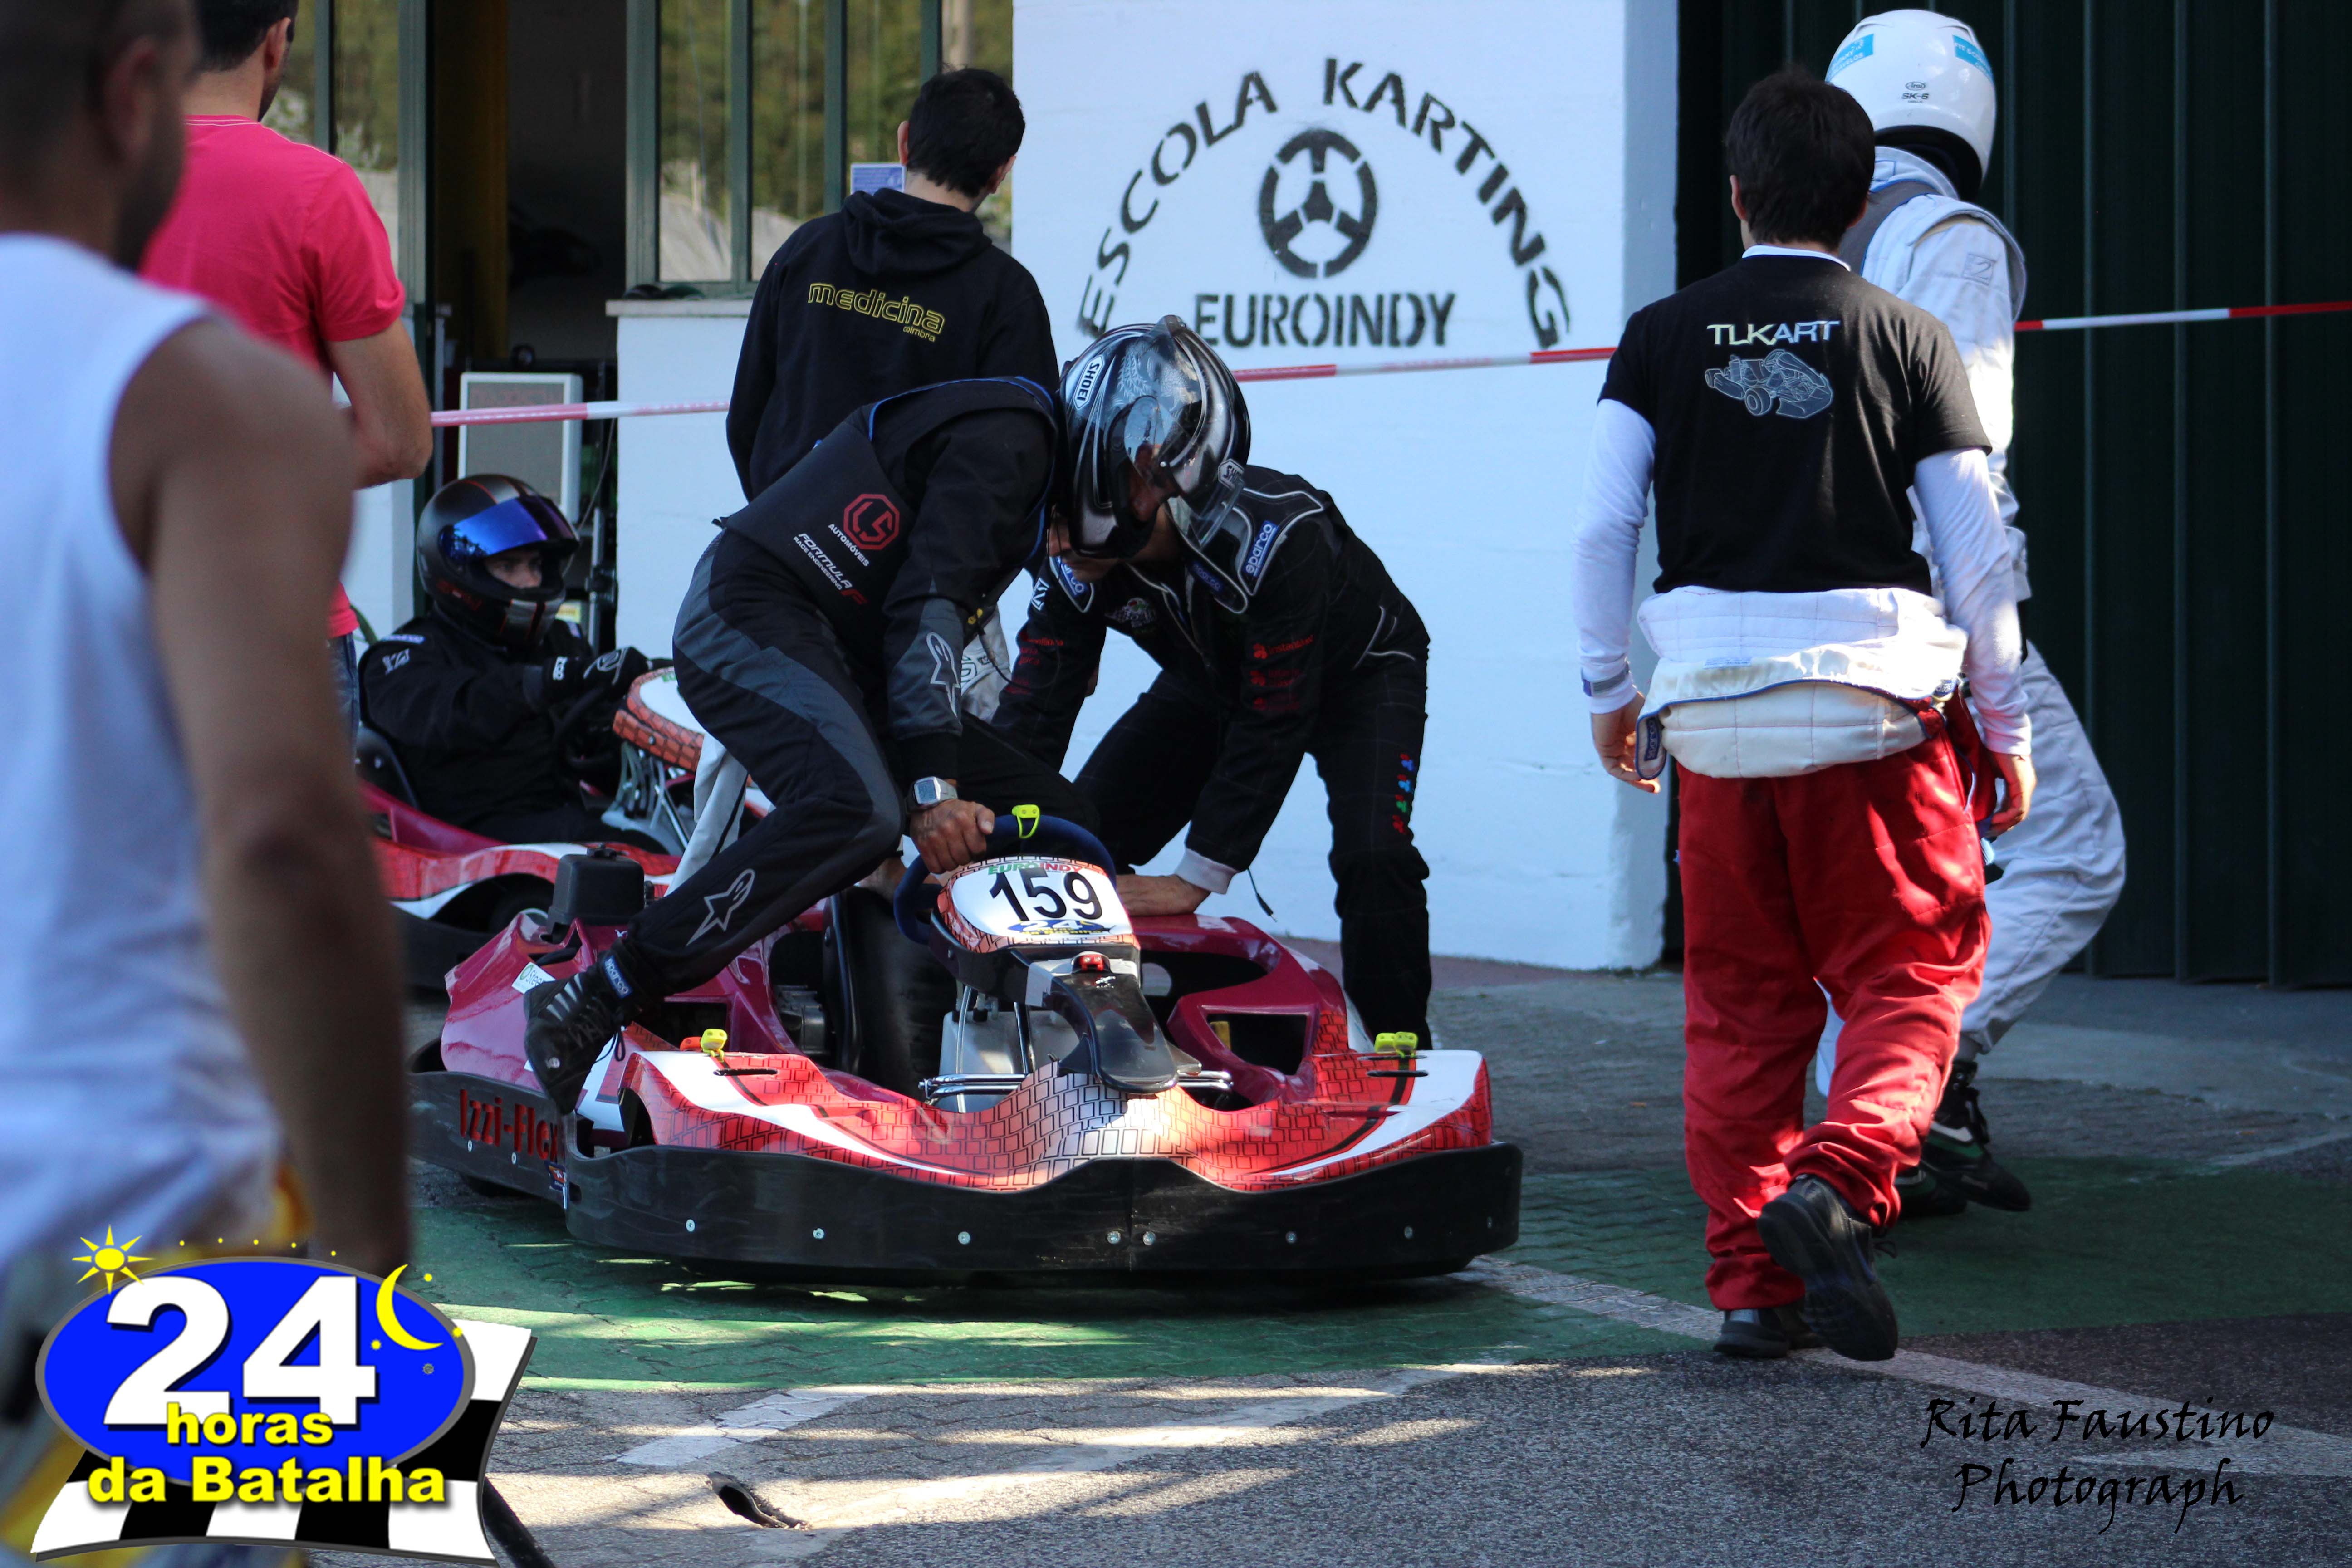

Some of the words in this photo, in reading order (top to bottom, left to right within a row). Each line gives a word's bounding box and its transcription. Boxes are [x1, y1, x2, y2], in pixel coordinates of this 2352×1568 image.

[1076, 70, 1278, 338] ESCOLA
[1323, 57, 1570, 350] KARTING
[808, 283, 946, 335] medicina
[1195, 294, 1455, 348] EUROINDY
[1706, 320, 1841, 346] TLKART
[903, 326, 936, 343] coimbra
[1076, 363, 1100, 401] SHOEI
[794, 536, 809, 555] RACE
[808, 552, 843, 590] ENGINEERING
[798, 533, 853, 588] FORMULA
[828, 524, 870, 567] AUTOMÓVEIS
[1245, 524, 1273, 574] sparco
[988, 862, 1083, 875] EUROINDY
[989, 867, 1102, 921] 159
[1020, 920, 1083, 931] 24
